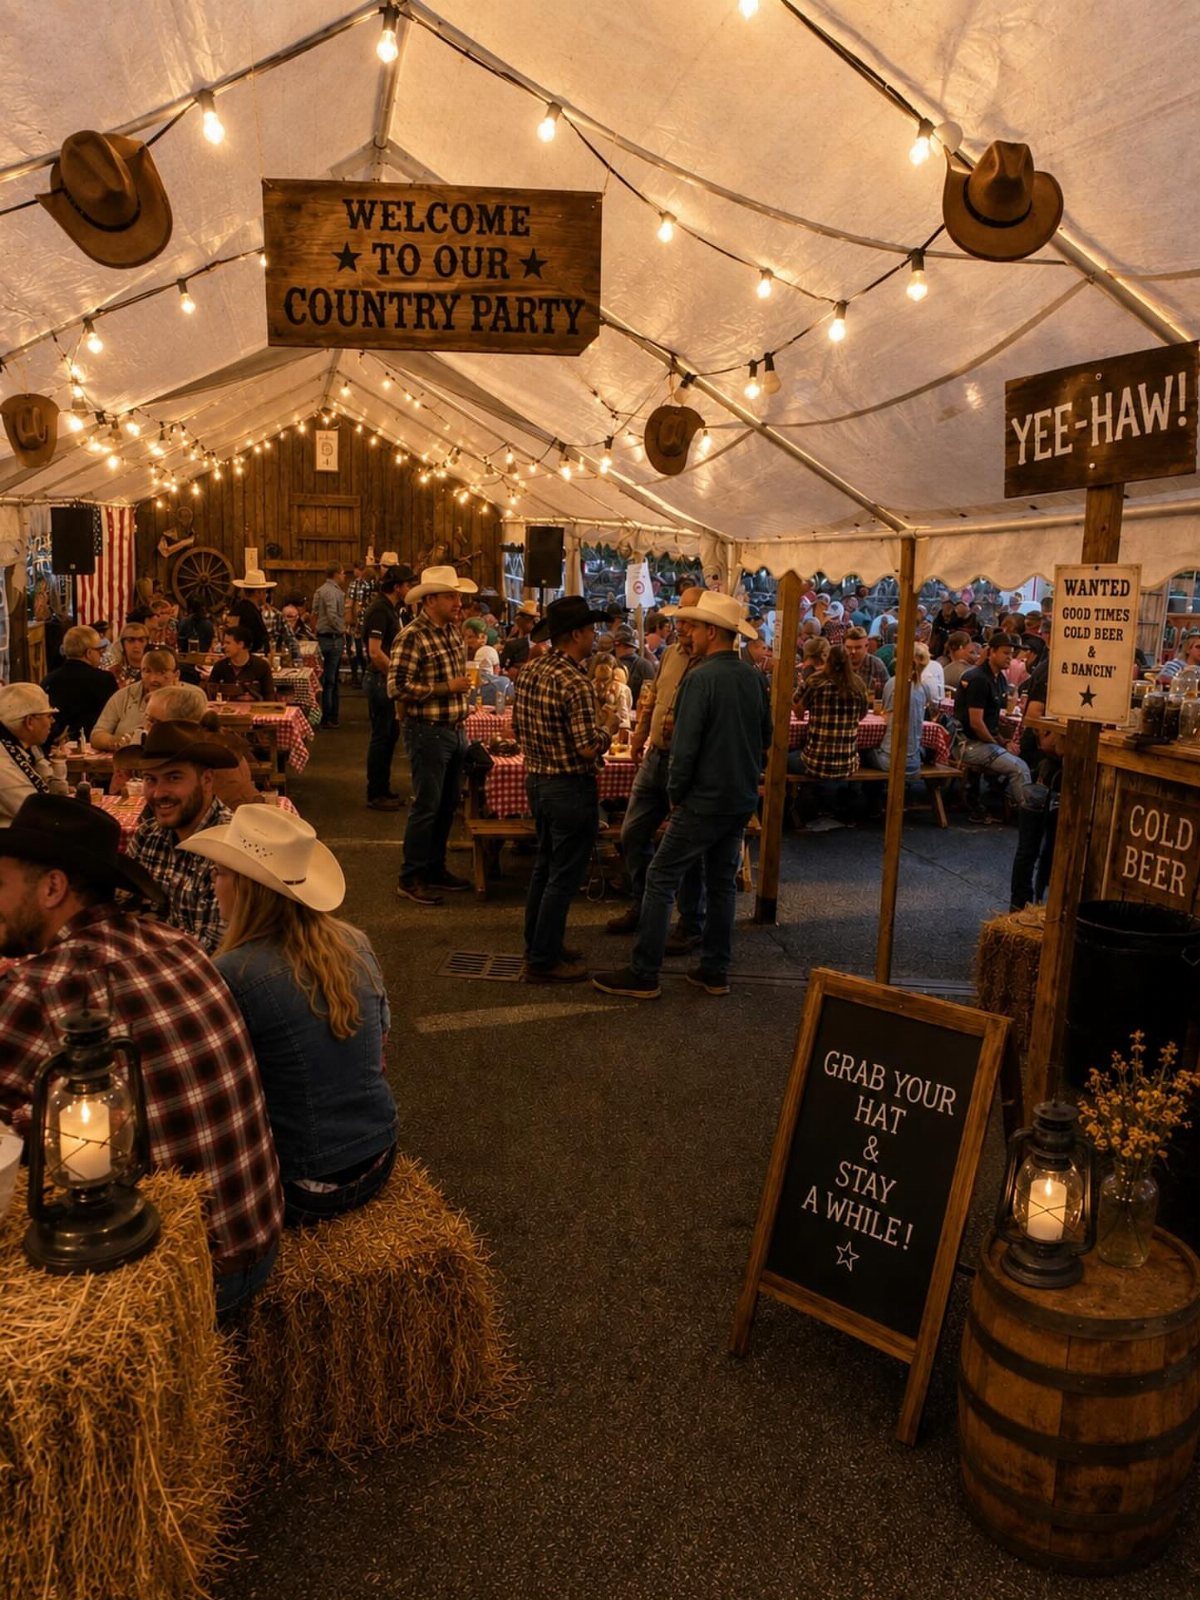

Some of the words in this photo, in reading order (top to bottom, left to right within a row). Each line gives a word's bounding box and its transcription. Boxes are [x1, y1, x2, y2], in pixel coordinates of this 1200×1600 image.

[343, 199, 531, 237] WELCOME
[372, 242, 422, 277] TO
[433, 244, 510, 280] OUR
[283, 286, 461, 331] COUNTRY
[471, 294, 586, 336] PARTY
[1011, 371, 1187, 466] YEE-HAW!
[1064, 579, 1131, 597] WANTED
[1062, 607, 1091, 621] GOOD
[1094, 608, 1130, 622] TIMES
[1063, 626, 1091, 639] COLD
[1094, 627, 1124, 642] BEER
[1071, 662, 1117, 679] DANCIN'
[1087, 645, 1096, 659] &
[1129, 804, 1193, 851] COLD
[1122, 845, 1186, 897] BEER
[823, 1050, 886, 1091] GRAB
[894, 1070, 956, 1116] YOUR
[854, 1095, 907, 1135] HAT
[863, 1135, 879, 1163] &
[835, 1160, 897, 1204] STAY
[801, 1185, 819, 1215] A
[826, 1191, 914, 1250] WHILE!
